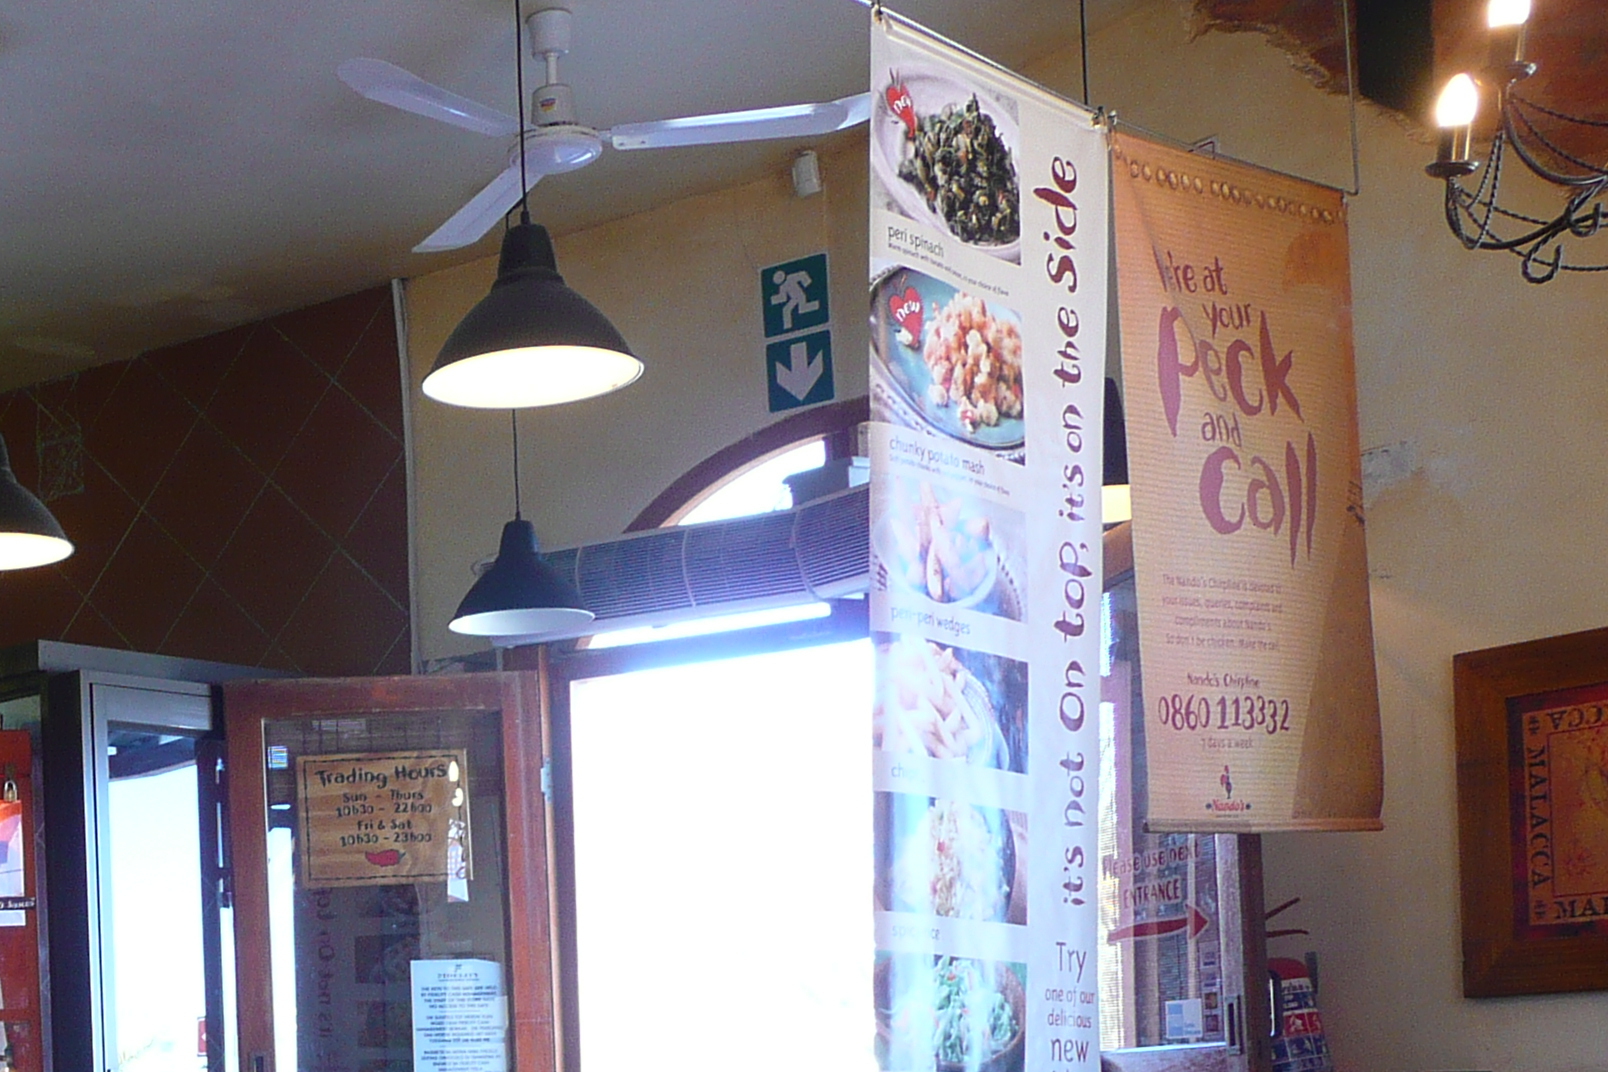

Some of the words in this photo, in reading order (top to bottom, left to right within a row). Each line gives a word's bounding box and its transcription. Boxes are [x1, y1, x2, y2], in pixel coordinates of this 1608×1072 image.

[888, 226, 907, 241] peri
[910, 234, 944, 258] spinach
[1203, 255, 1228, 295] at
[896, 299, 920, 324] new
[1202, 301, 1251, 339] your
[1053, 306, 1082, 389] the
[1201, 411, 1242, 447] and
[890, 435, 925, 461] chunky
[962, 459, 985, 475] mash
[1058, 463, 1086, 521] it's
[936, 616, 970, 637] wedges
[1158, 693, 1210, 731] 0860
[1217, 695, 1290, 735] 113332
[315, 767, 388, 789] Trading
[1058, 752, 1086, 828] not
[336, 804, 374, 817] 10h30
[393, 802, 432, 814] 22h00
[342, 793, 367, 803] Sun
[390, 789, 424, 800] Thurs
[1212, 799, 1245, 812] Nando's
[357, 820, 374, 831] Fri
[390, 819, 413, 830] Sat
[1528, 745, 1551, 887] MALACCA
[340, 833, 379, 847] 10h30
[393, 832, 433, 843] 23h00
[1063, 844, 1086, 907] it's
[1123, 879, 1180, 908] ENTRANCE
[1056, 942, 1087, 983] Try
[1045, 988, 1064, 1002] one
[1066, 986, 1077, 1007] of
[1080, 991, 1095, 1004] our
[1047, 1008, 1092, 1028] delicious
[1051, 1037, 1089, 1063] new
